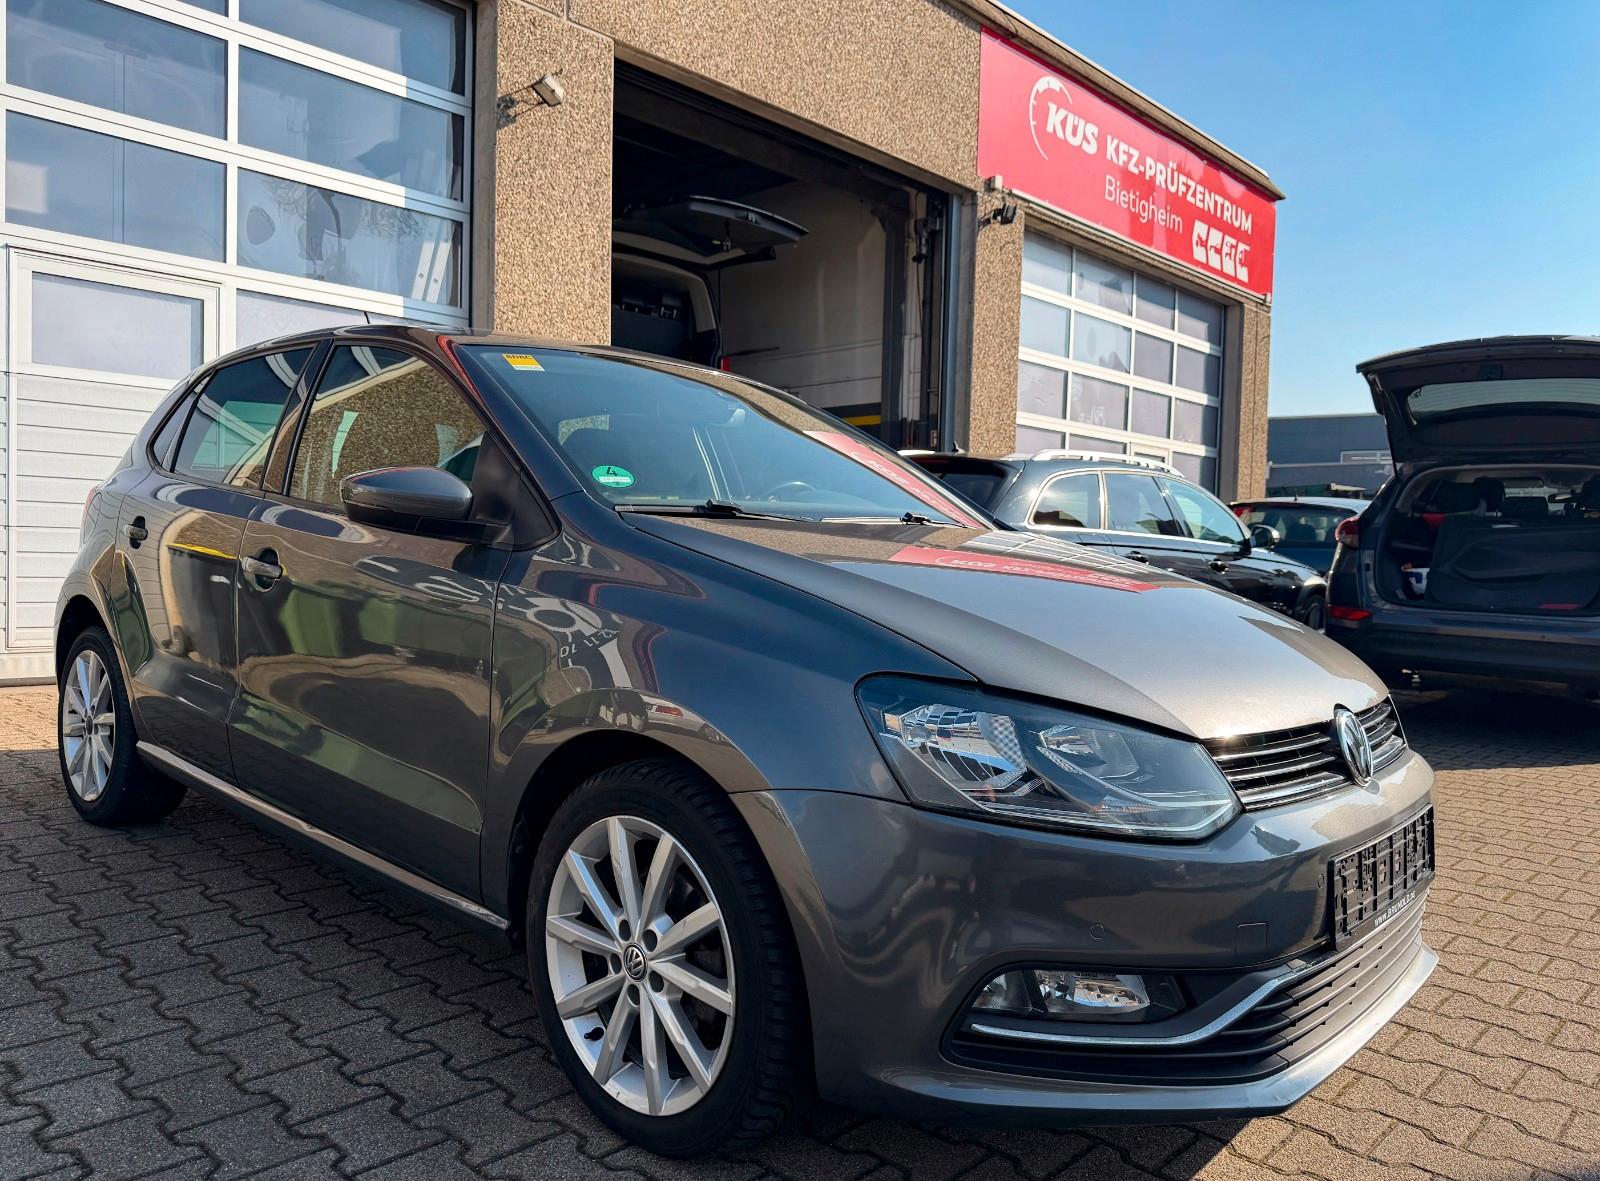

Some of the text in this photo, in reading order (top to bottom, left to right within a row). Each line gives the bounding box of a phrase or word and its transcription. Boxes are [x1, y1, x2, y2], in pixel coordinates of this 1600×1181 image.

[1046, 101, 1252, 235] KÜS KFZ-PRÜFZENTRUM
[1105, 174, 1183, 235] Bietigheim
[605, 466, 618, 477] 4
